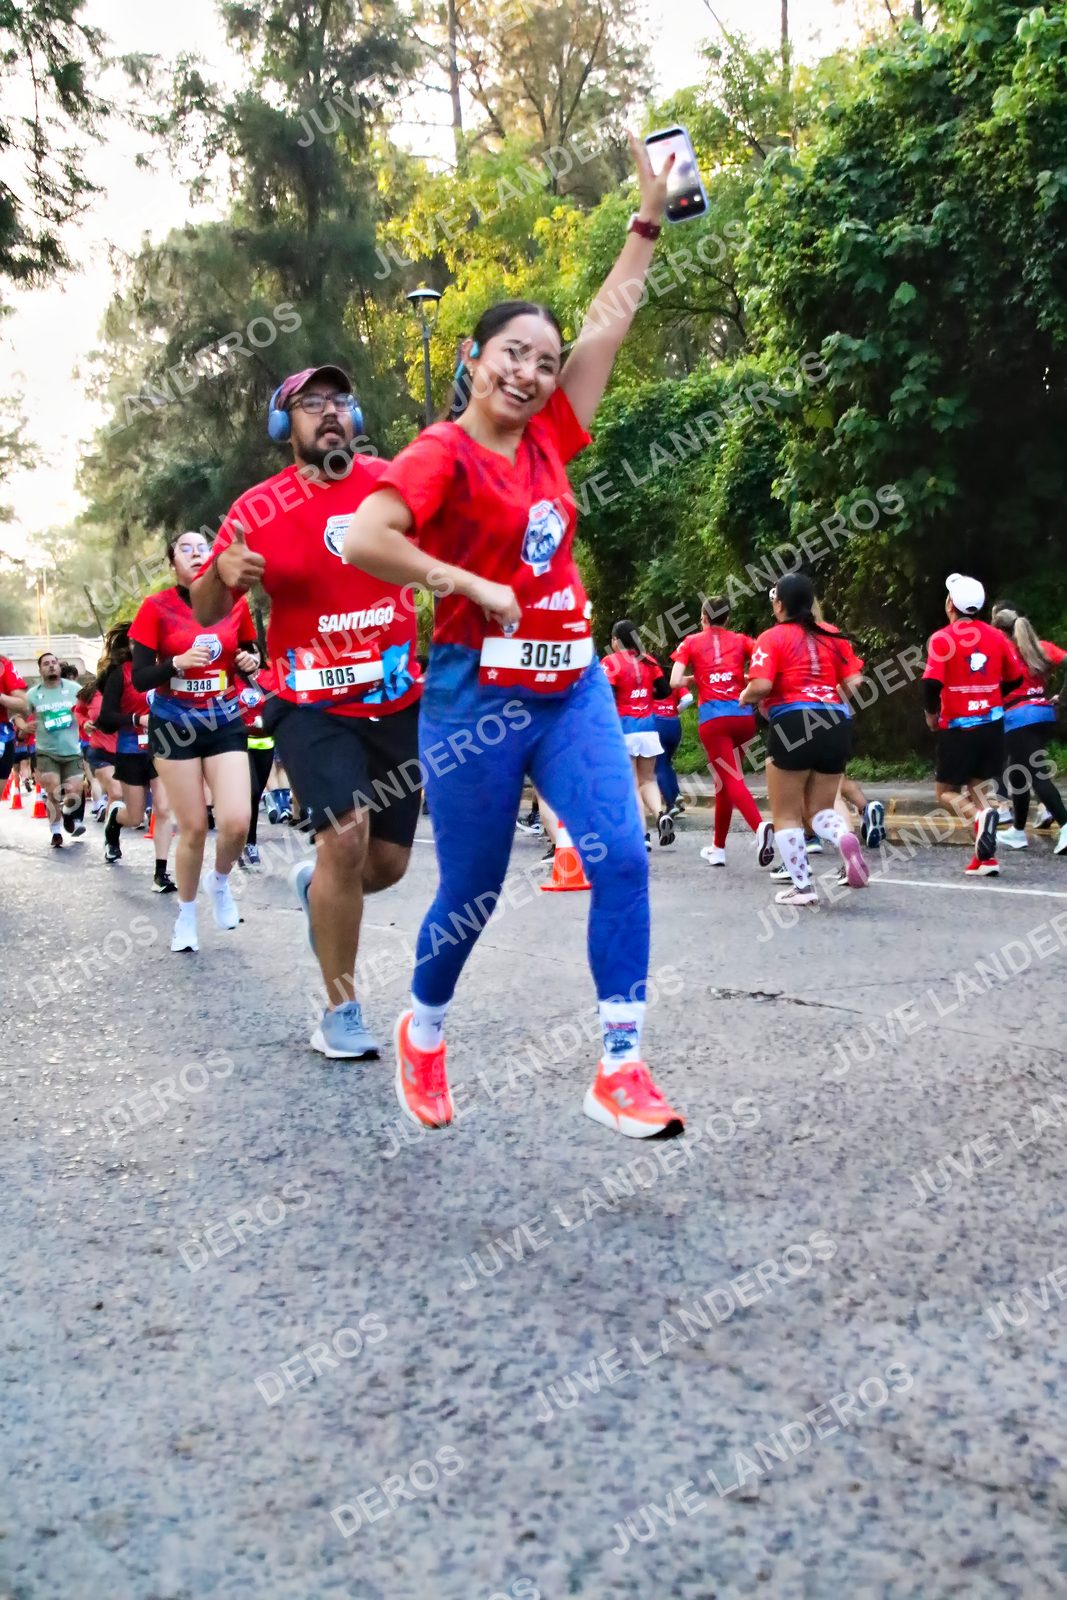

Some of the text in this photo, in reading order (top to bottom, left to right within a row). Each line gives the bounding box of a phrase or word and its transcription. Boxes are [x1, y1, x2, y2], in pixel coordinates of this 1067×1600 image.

[318, 606, 394, 632] SANTIAGO
[520, 643, 572, 668] 3054
[186, 680, 212, 691] 3348
[319, 666, 356, 687] 1805
